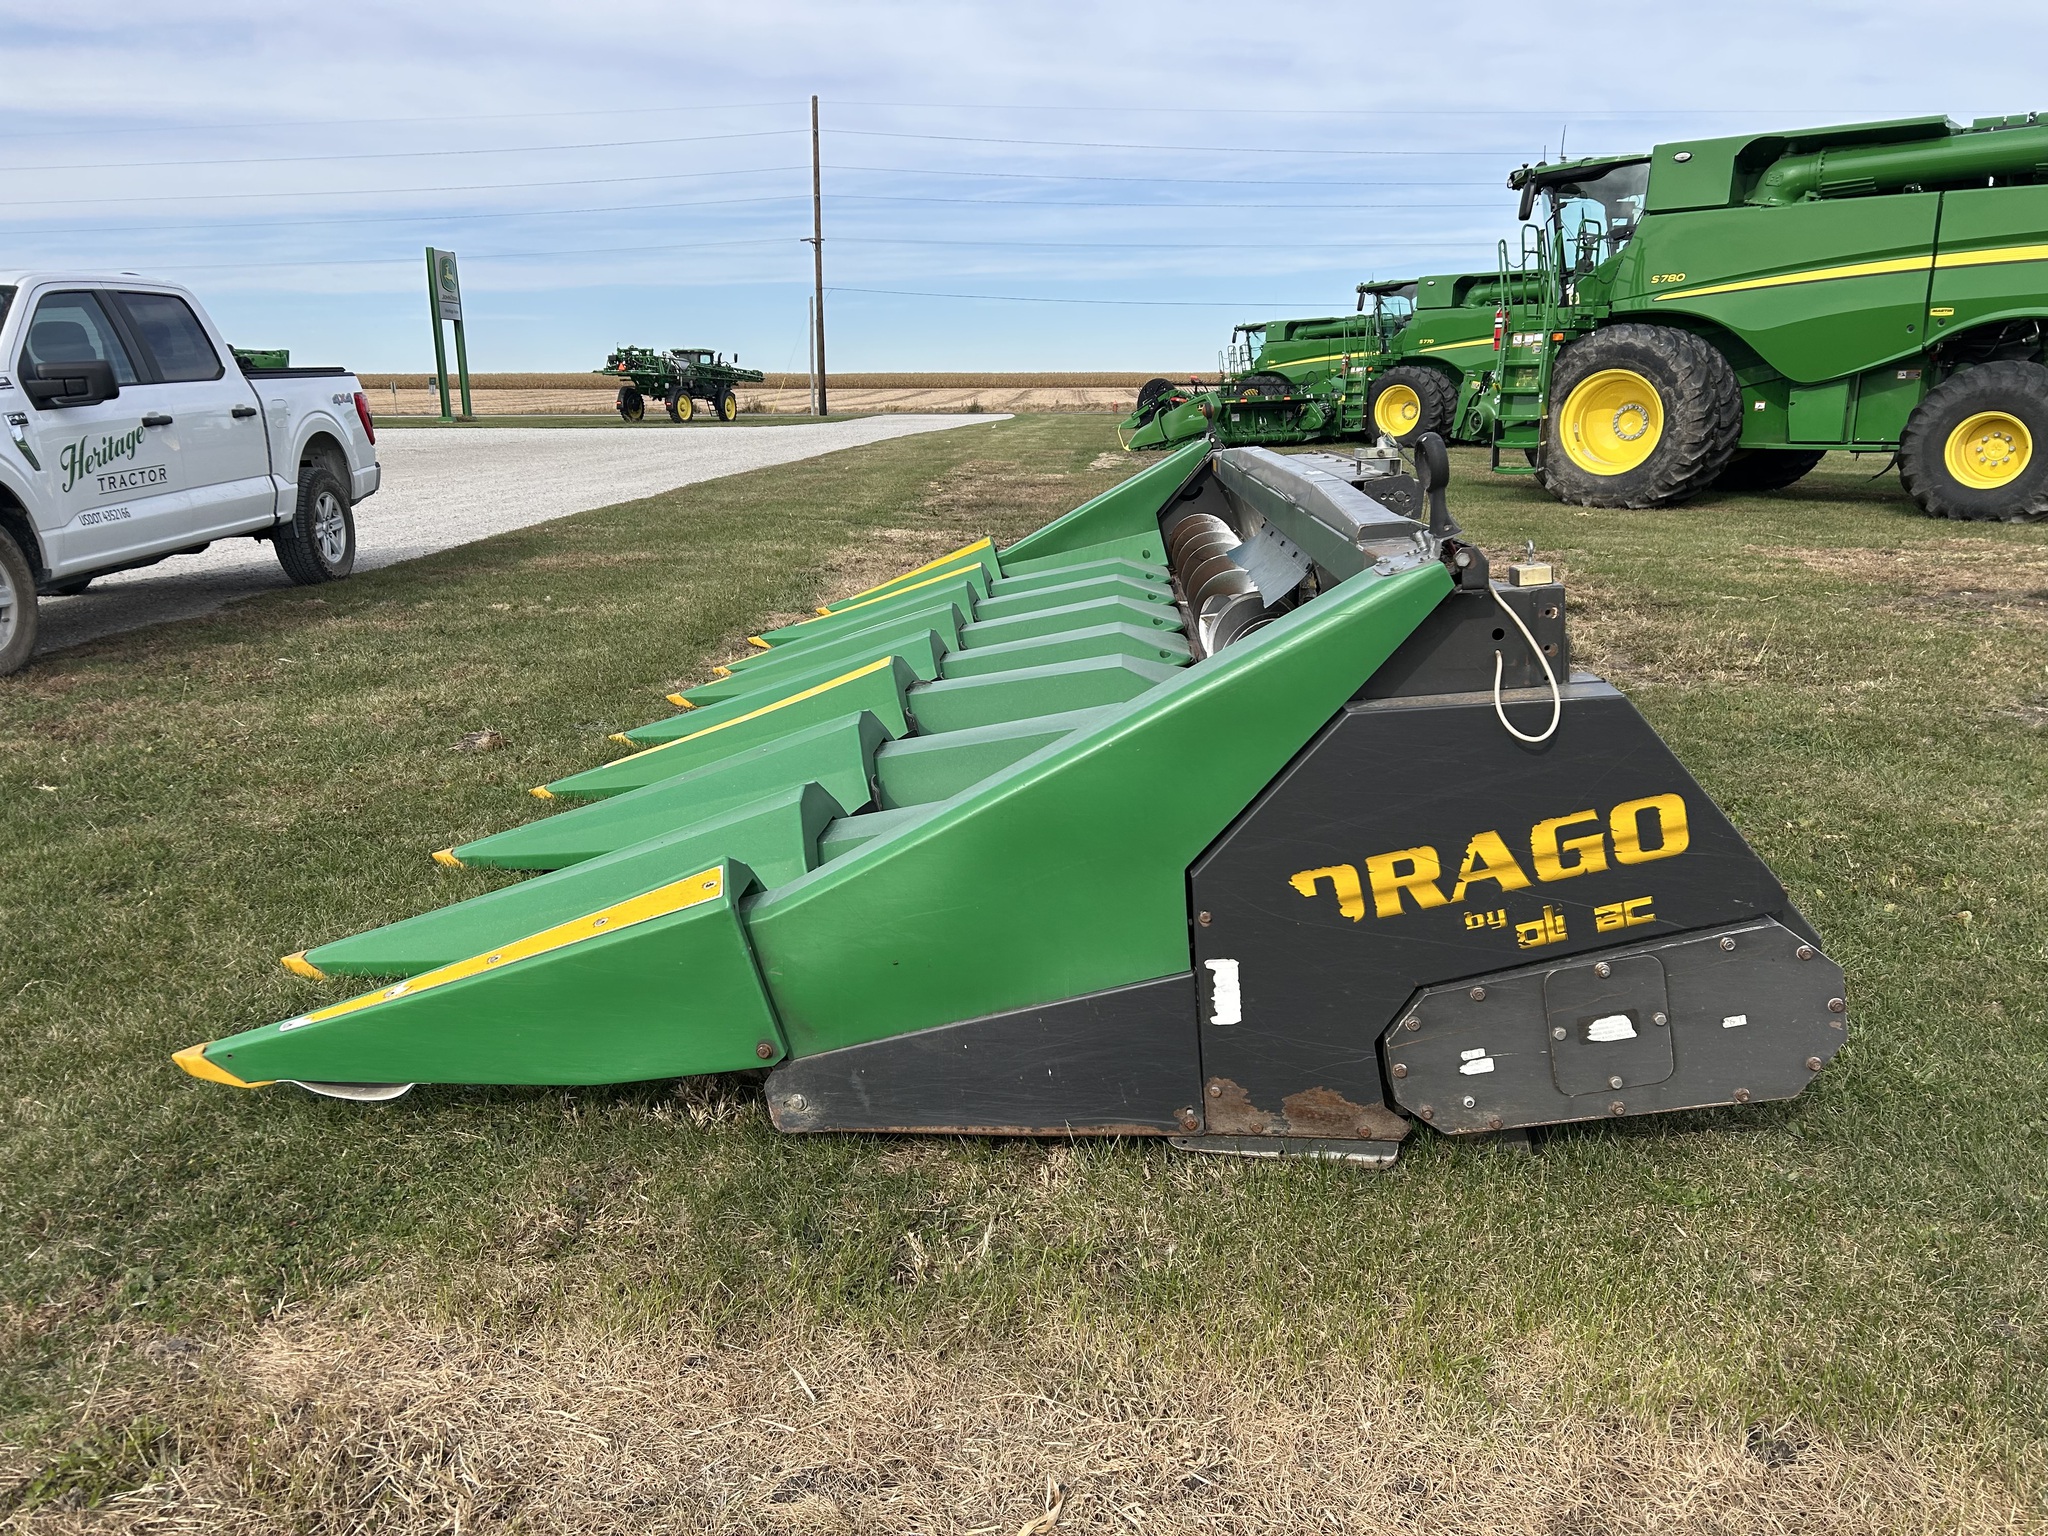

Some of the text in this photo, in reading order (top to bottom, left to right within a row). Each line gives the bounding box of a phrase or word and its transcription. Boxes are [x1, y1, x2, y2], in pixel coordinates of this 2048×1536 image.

[60, 425, 145, 493] Heritage
[97, 467, 167, 492] TRACTOR
[78, 512, 103, 526] USDOT
[1464, 908, 1508, 930] by
